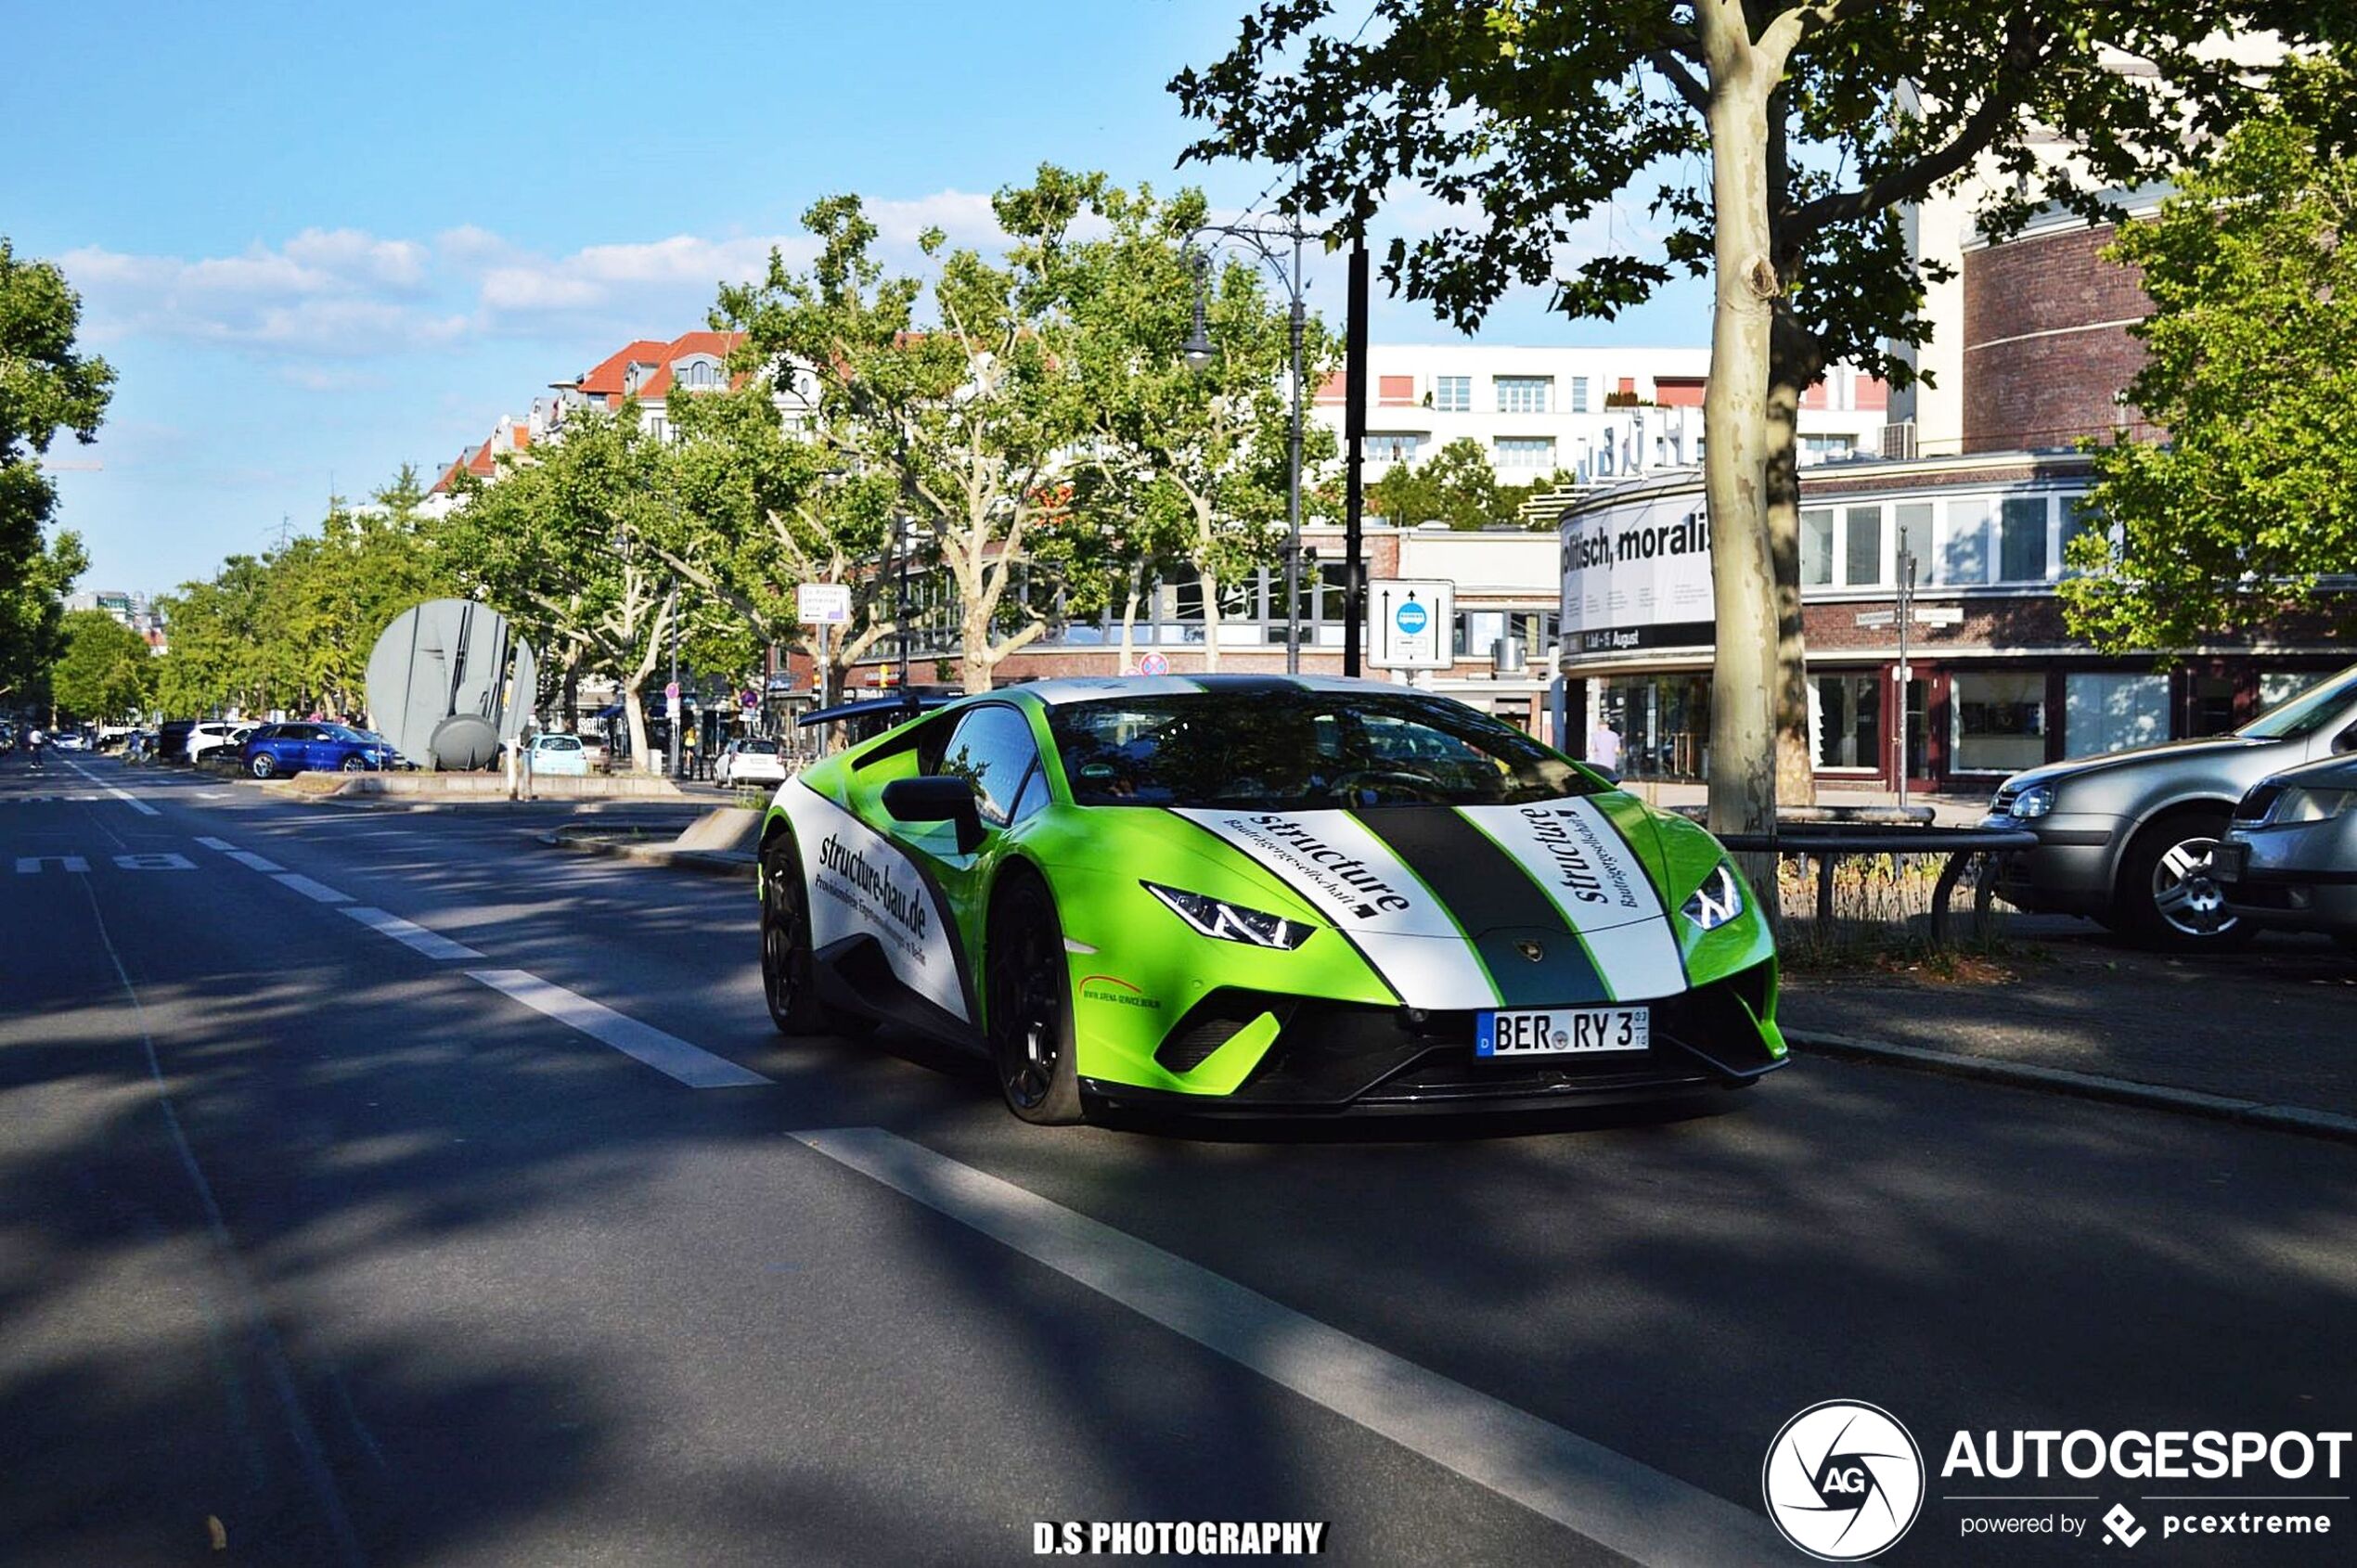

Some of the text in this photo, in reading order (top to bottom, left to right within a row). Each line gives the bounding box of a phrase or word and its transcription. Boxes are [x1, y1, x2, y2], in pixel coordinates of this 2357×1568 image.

[1618, 512, 1712, 562] morali
[1612, 628, 1640, 649] August
[818, 832, 926, 940] structure-bau.de
[1250, 815, 1410, 913] structure
[1520, 807, 1609, 905] structure
[1480, 1011, 1633, 1051] D BER RY 3
